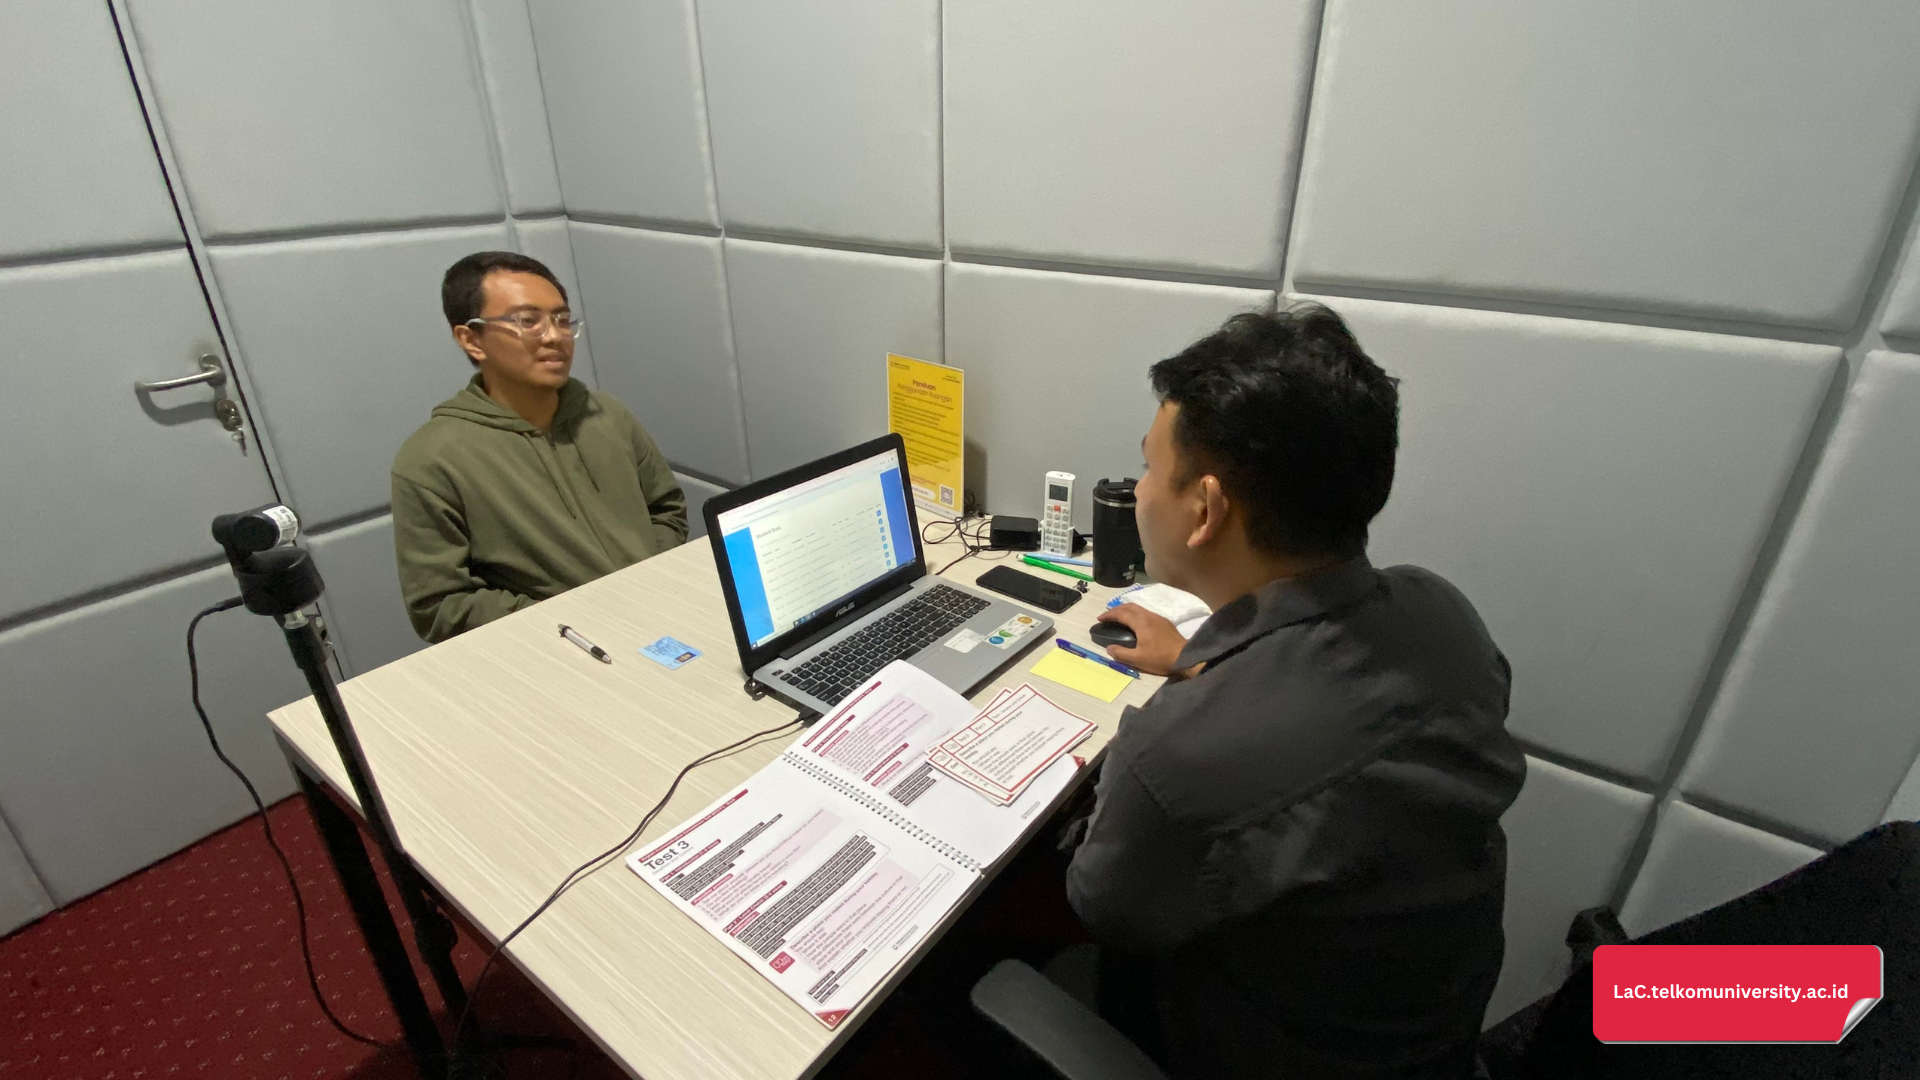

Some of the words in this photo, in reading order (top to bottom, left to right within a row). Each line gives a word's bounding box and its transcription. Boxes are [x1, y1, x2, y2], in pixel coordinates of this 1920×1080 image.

[835, 602, 855, 618] ASUS
[643, 846, 679, 872] Test
[675, 838, 690, 850] 3
[826, 1013, 837, 1023] 12
